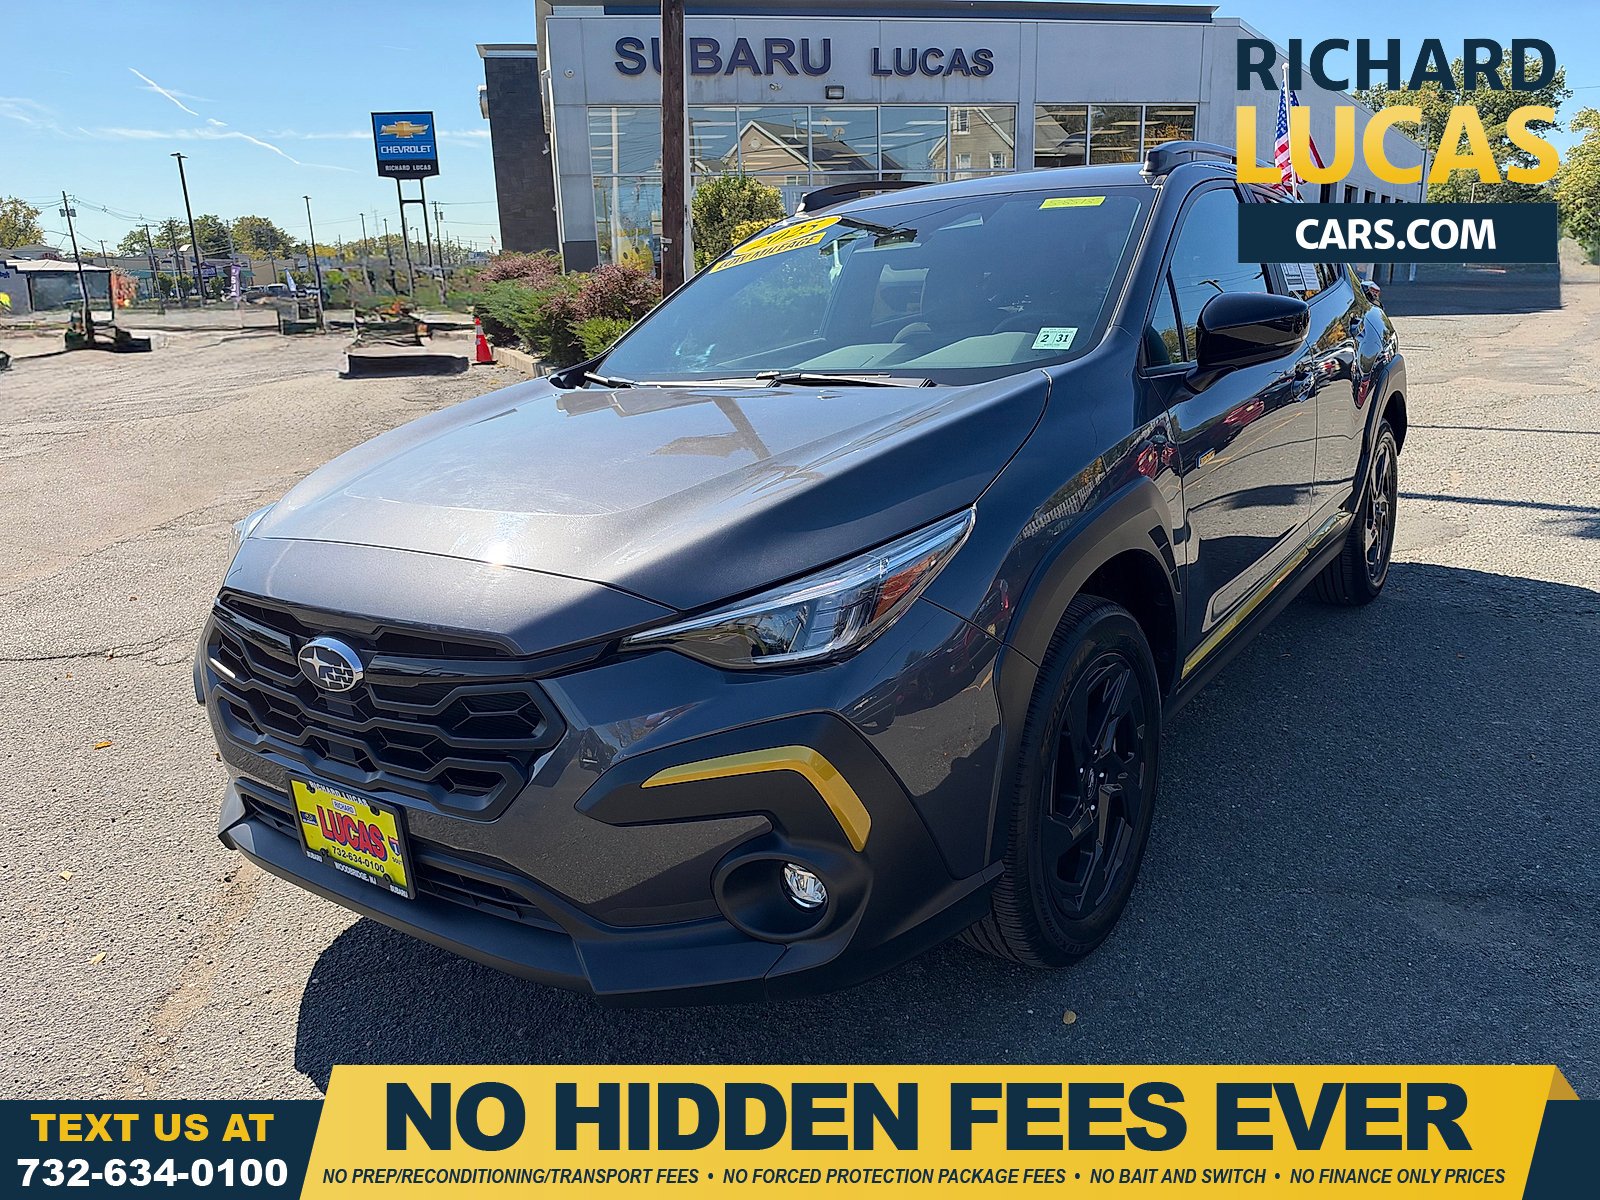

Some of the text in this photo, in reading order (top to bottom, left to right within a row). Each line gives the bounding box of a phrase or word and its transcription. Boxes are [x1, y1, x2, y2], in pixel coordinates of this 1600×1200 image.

[871, 47, 995, 77] LUCAS
[380, 145, 432, 154] CHEVROLET
[749, 235, 818, 261] MILEAGE
[1040, 334, 1070, 343] 2 31
[308, 780, 369, 807] RICHARD LUCAS
[316, 805, 388, 862] LUCAS
[332, 845, 386, 874] 732-634-0100
